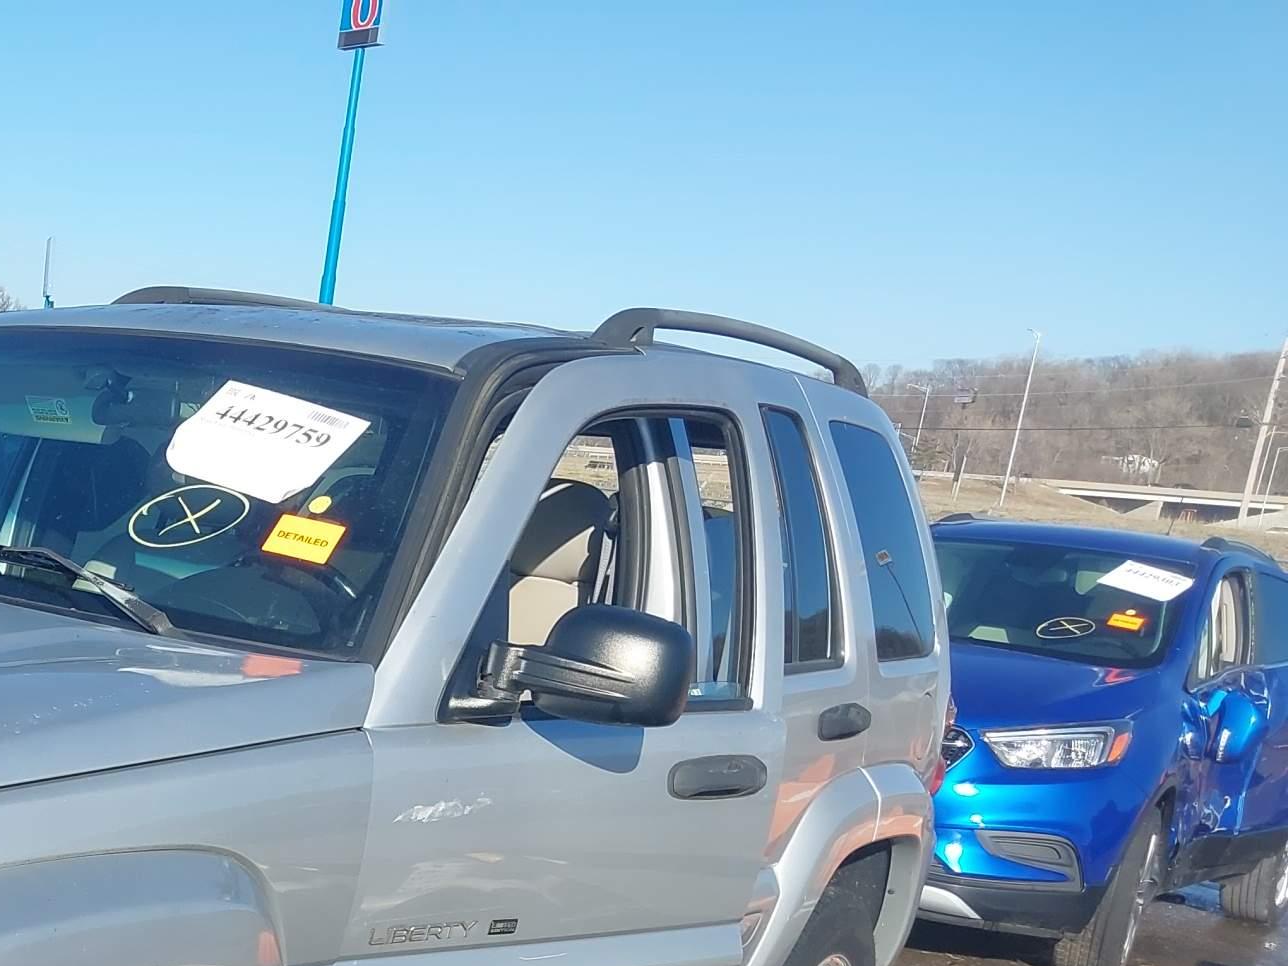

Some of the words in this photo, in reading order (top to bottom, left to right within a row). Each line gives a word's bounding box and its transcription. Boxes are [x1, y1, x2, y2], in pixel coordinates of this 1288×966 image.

[215, 405, 332, 448] 44429759
[277, 530, 329, 548] DETAILED
[368, 920, 479, 945] LIBERTY
